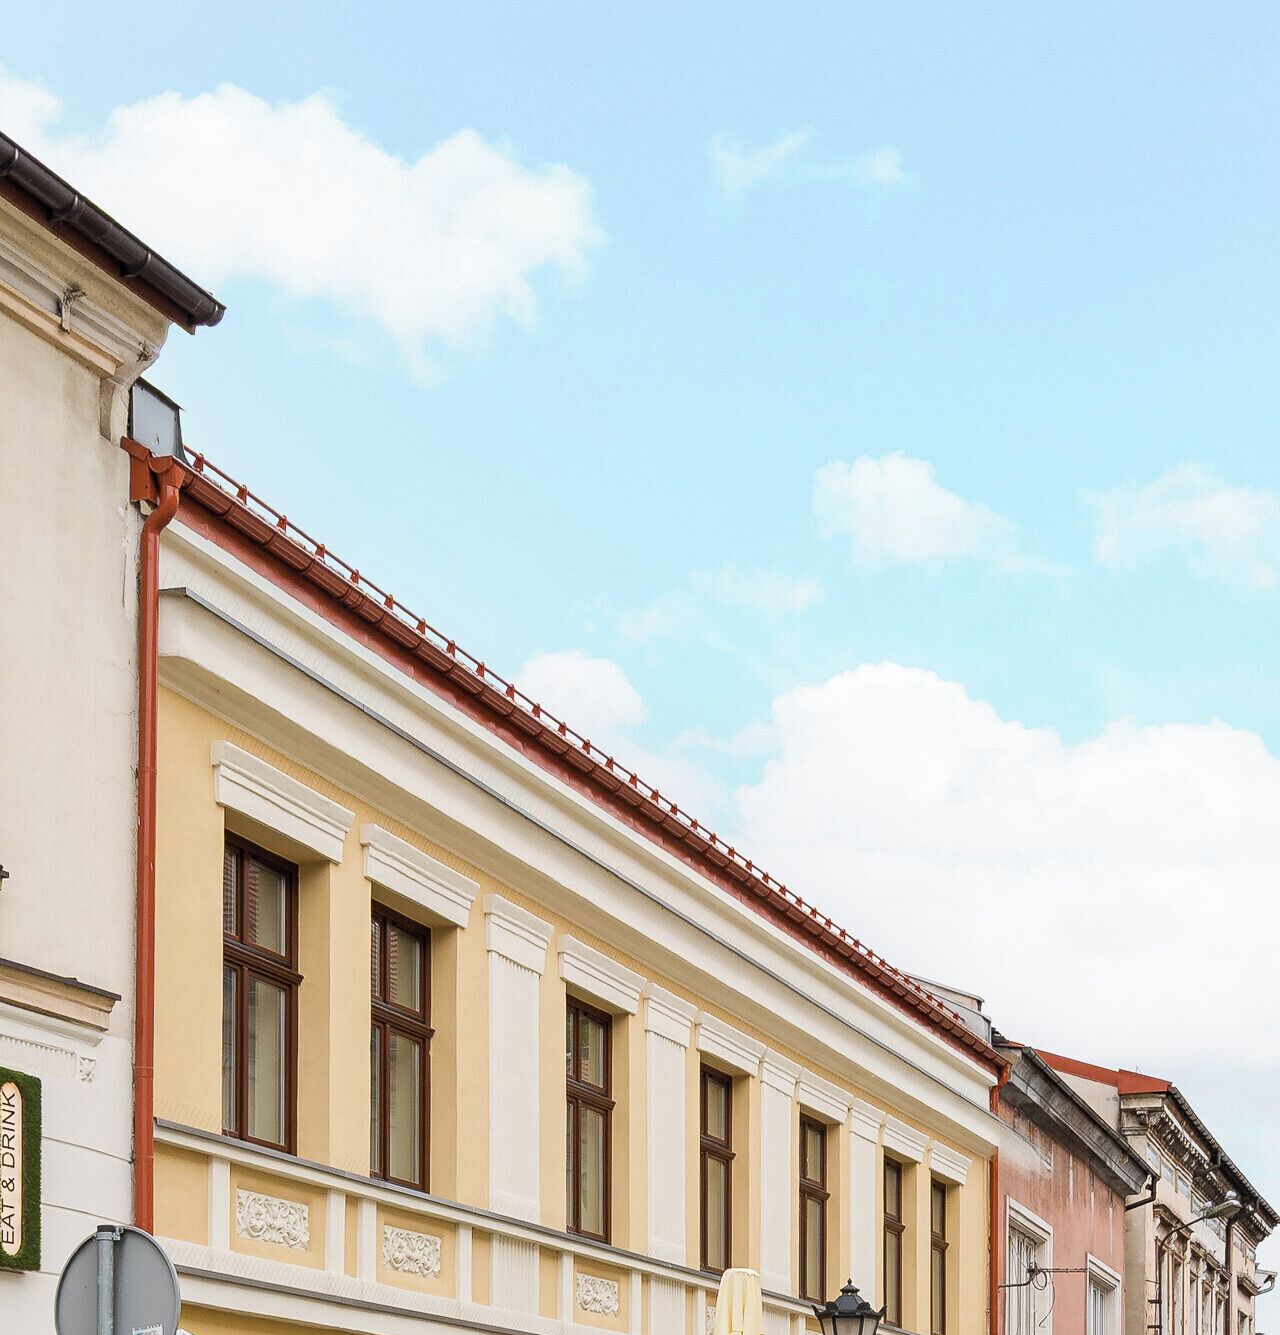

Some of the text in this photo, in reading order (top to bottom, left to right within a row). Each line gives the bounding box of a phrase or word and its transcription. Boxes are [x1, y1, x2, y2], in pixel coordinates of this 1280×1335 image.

[1, 1092, 16, 1245] EAT & DRINK
